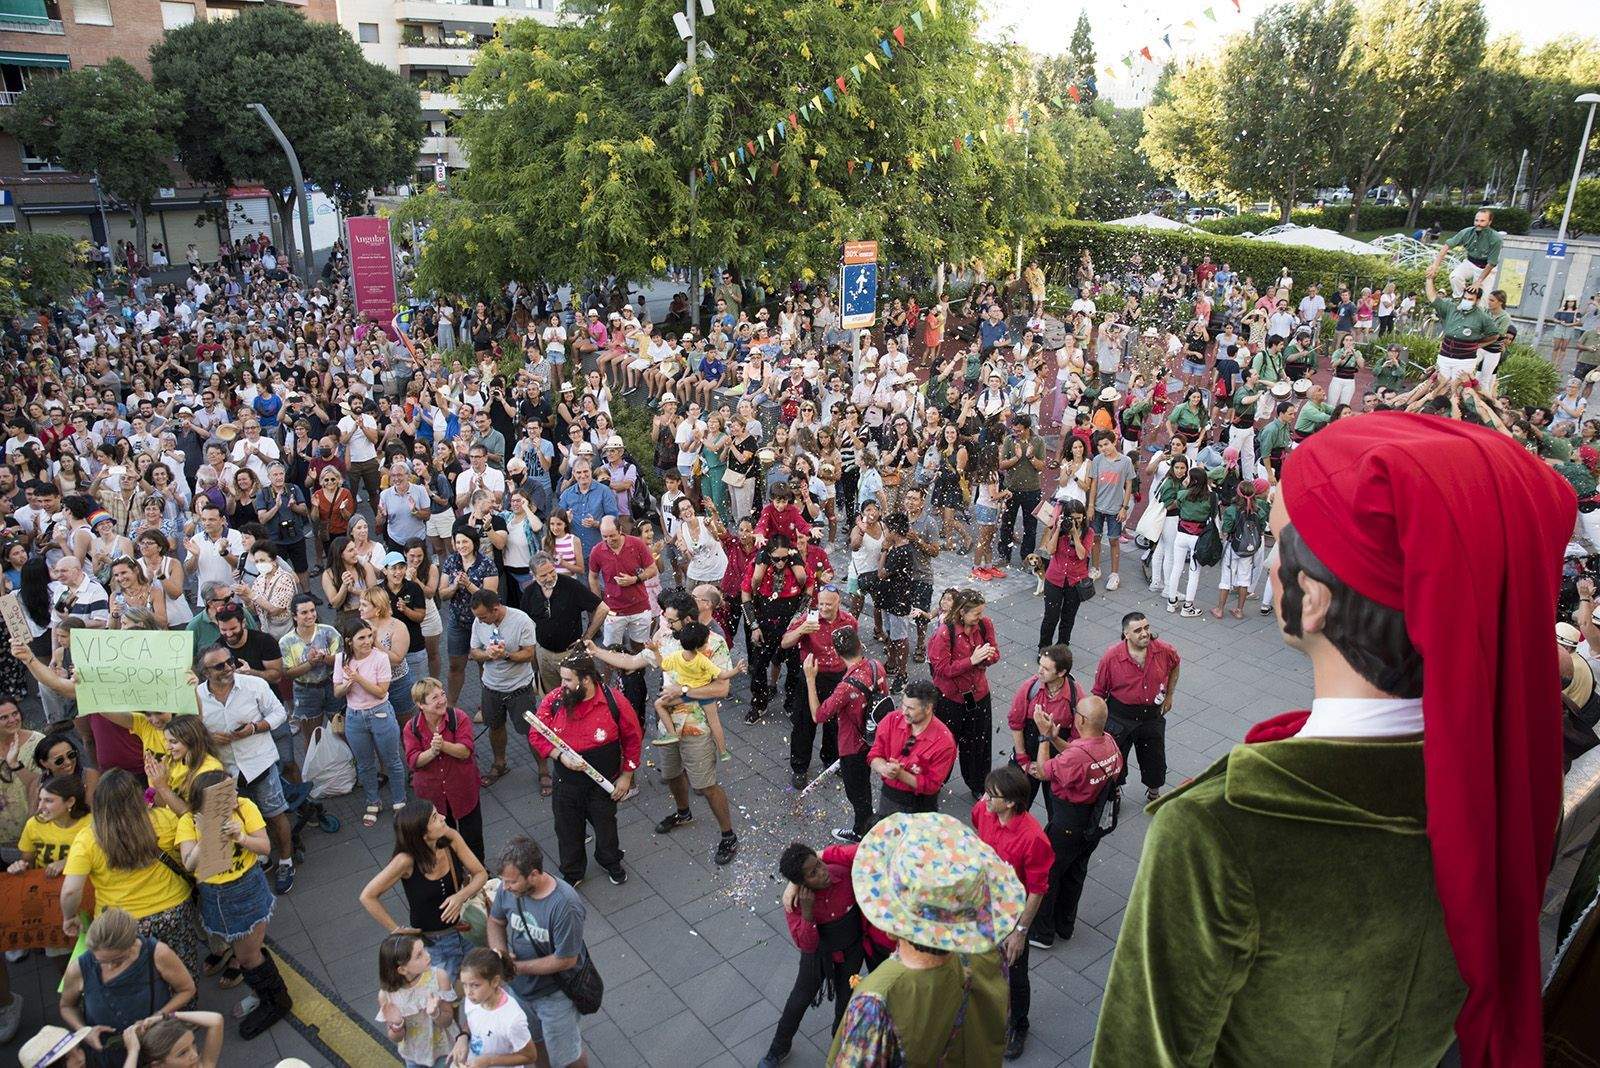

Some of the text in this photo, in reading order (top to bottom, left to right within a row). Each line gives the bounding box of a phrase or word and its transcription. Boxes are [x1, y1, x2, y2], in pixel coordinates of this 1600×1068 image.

[354, 234, 386, 244] Angular
[76, 636, 152, 662] VISCA
[78, 666, 183, 687] L'ESPORT
[32, 843, 70, 867] FEF
